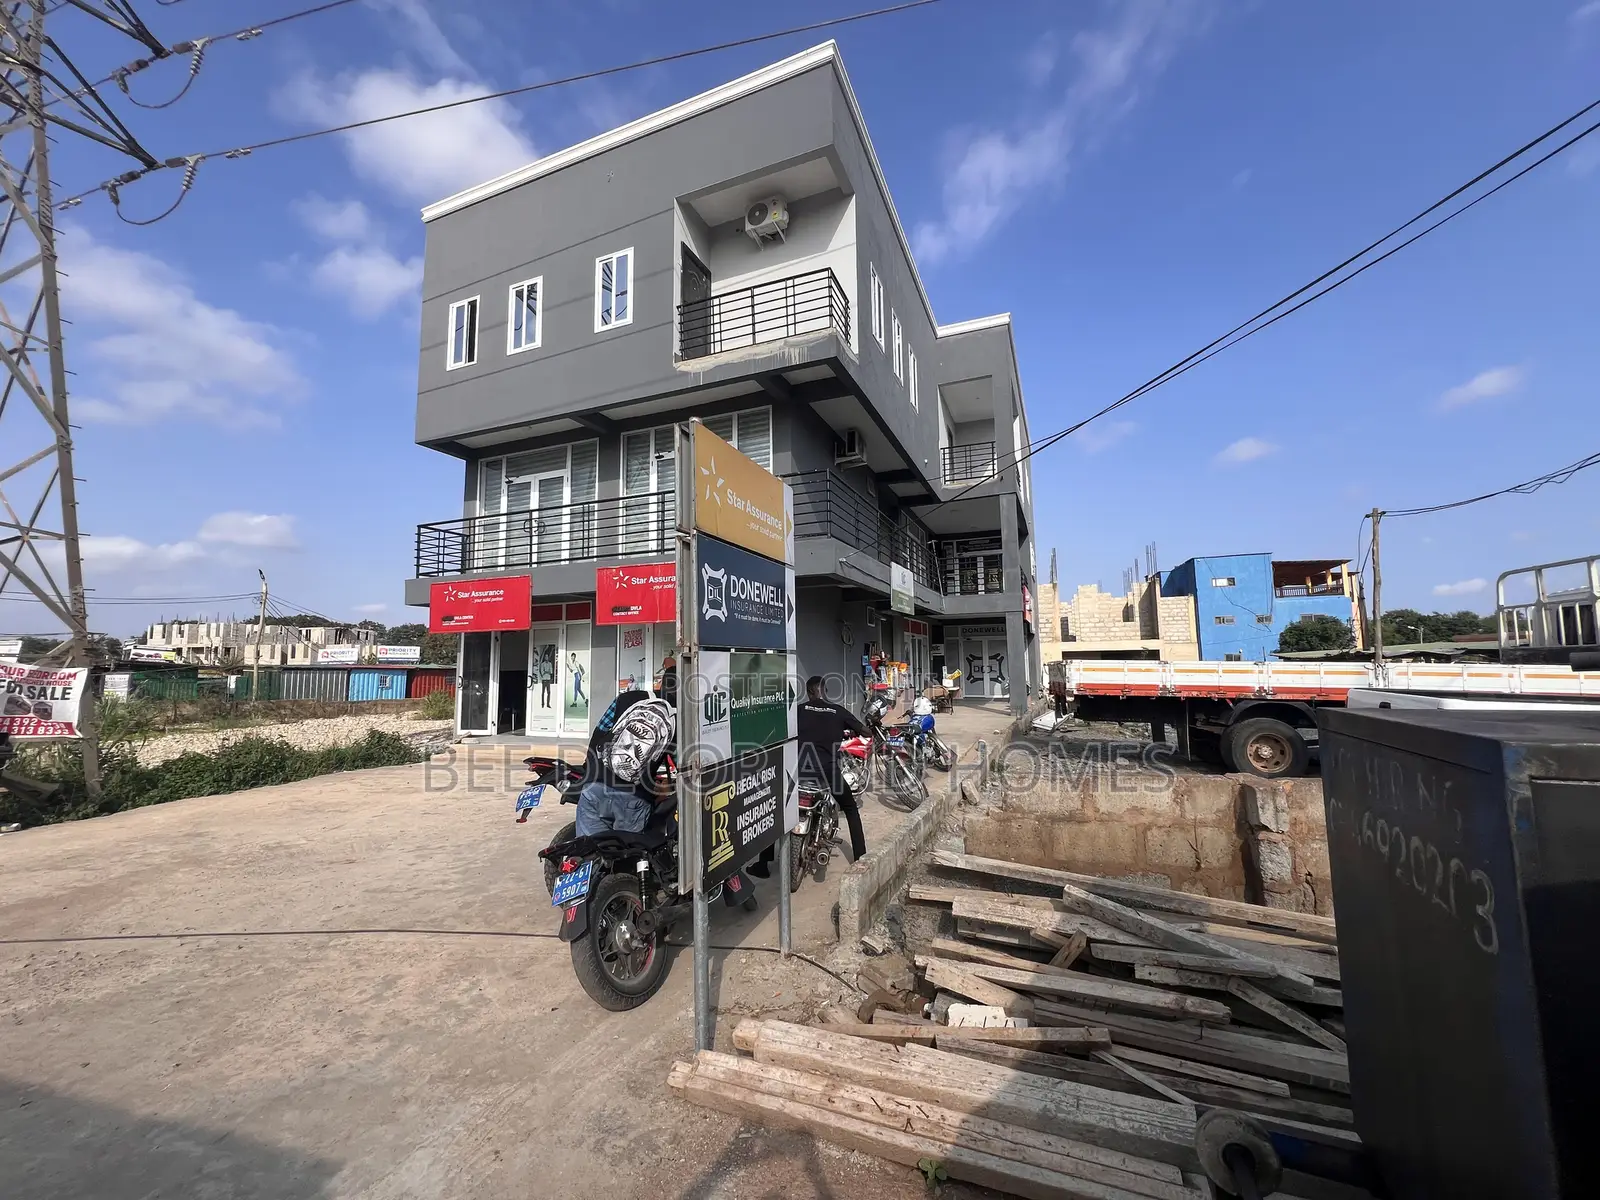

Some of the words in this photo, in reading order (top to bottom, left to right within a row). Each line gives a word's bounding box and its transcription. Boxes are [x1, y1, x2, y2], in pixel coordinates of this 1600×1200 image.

[727, 488, 745, 511] Star
[746, 500, 783, 530] Assurance
[631, 577, 647, 585] Star
[648, 575, 676, 584] Assura
[457, 591, 470, 599] Star
[471, 589, 504, 598] Assurance
[730, 575, 784, 607] DONEWELL
[730, 600, 764, 615] INSURANCE
[765, 605, 784, 619] LIMITED
[963, 626, 1005, 634] DONEWELL
[24, 685, 73, 701] SALE
[731, 696, 751, 709] Quality
[751, 695, 775, 706] Insurance
[775, 691, 785, 701] PLC
[11, 726, 35, 735] 313
[13, 718, 38, 726] 392
[736, 773, 760, 795] REGAL
[762, 765, 776, 784] RISK
[743, 786, 771, 806] MANAGEMENT
[736, 796, 777, 831] INSURANCE
[742, 813, 775, 845] BROKERS
[562, 882, 582, 899] 5907
